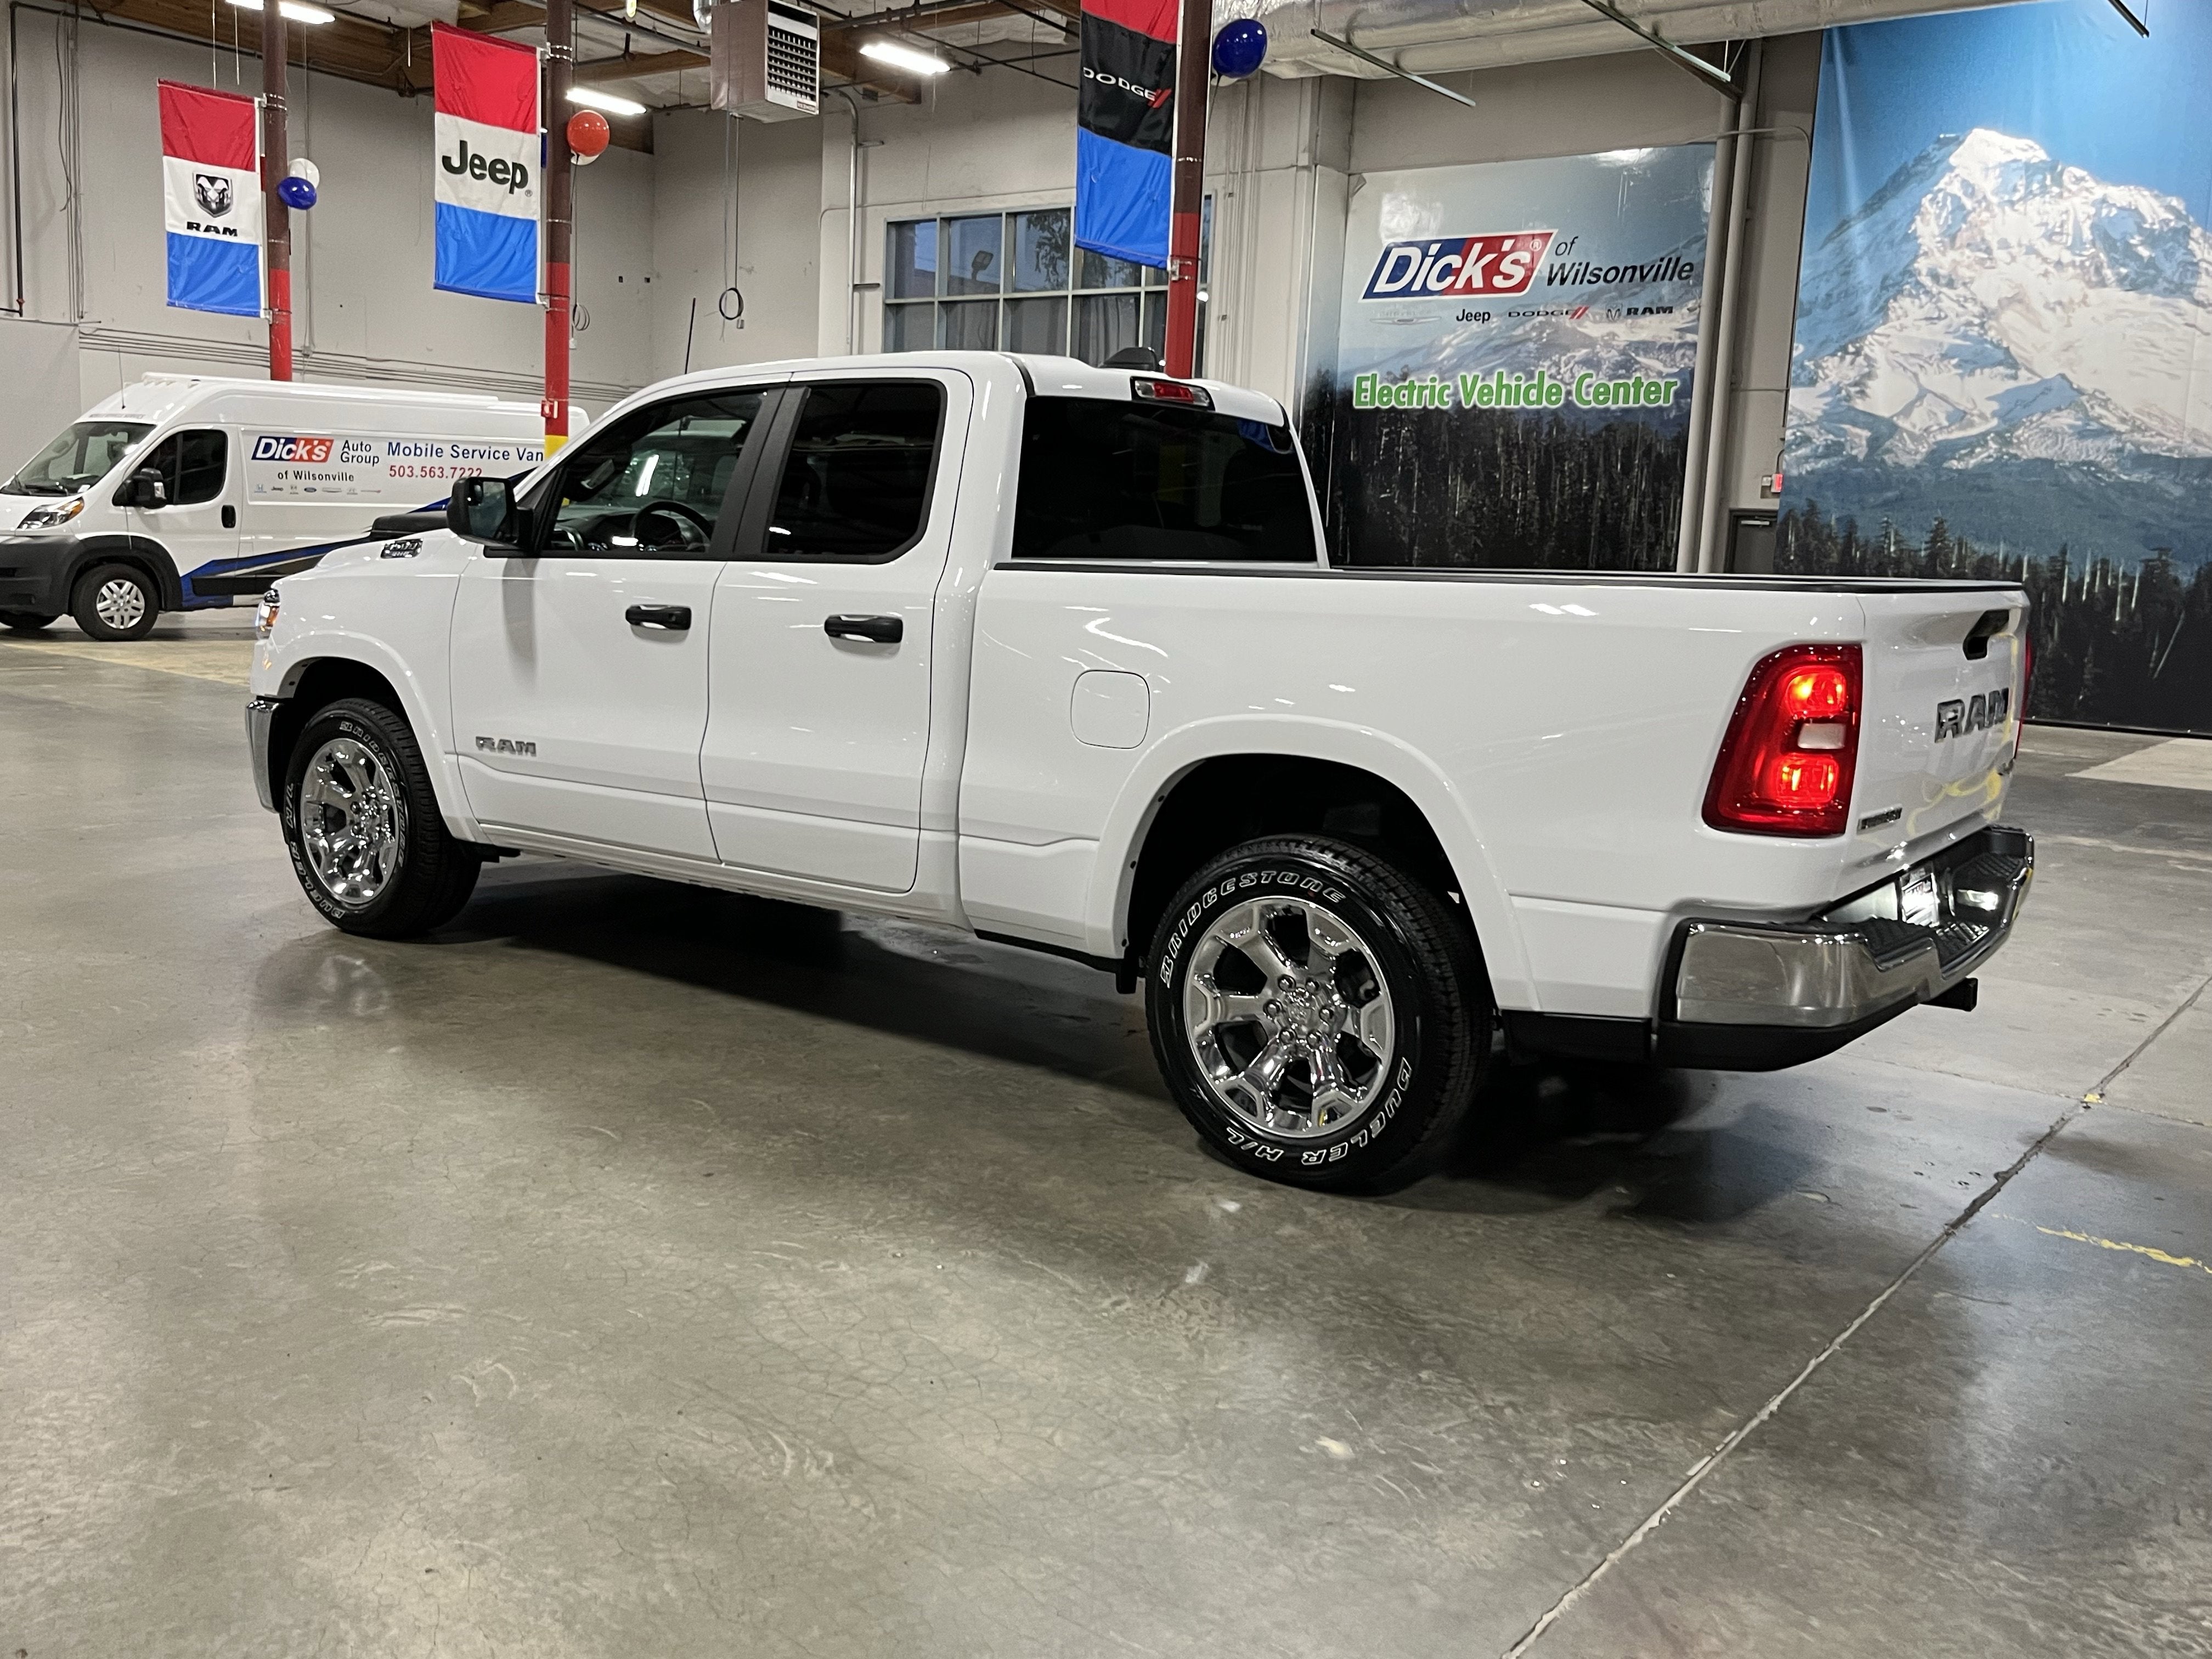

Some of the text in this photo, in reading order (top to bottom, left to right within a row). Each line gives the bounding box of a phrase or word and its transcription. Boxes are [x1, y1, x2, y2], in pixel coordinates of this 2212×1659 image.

[1084, 67, 1156, 101] DODGE
[442, 139, 528, 195] Jeep
[187, 221, 238, 236] RAM
[1373, 236, 1579, 293] Dick's of
[1547, 256, 1694, 286] Wilsonville
[1456, 309, 1491, 324] Jeep
[1627, 306, 1673, 316] RAM
[1354, 371, 1678, 407] Electric Vehicle Center
[256, 437, 372, 461] Dick's Auto
[340, 452, 380, 467] Group
[387, 442, 544, 461] Mobile Service Van
[278, 470, 354, 482] of Wilsonville
[389, 465, 483, 479] 503.563.7222
[1934, 687, 2009, 743] RAM
[475, 736, 537, 757] RAM
[1159, 870, 1346, 989] BRIDGESTONE
[1226, 1057, 1413, 1165] DUELER H/L
